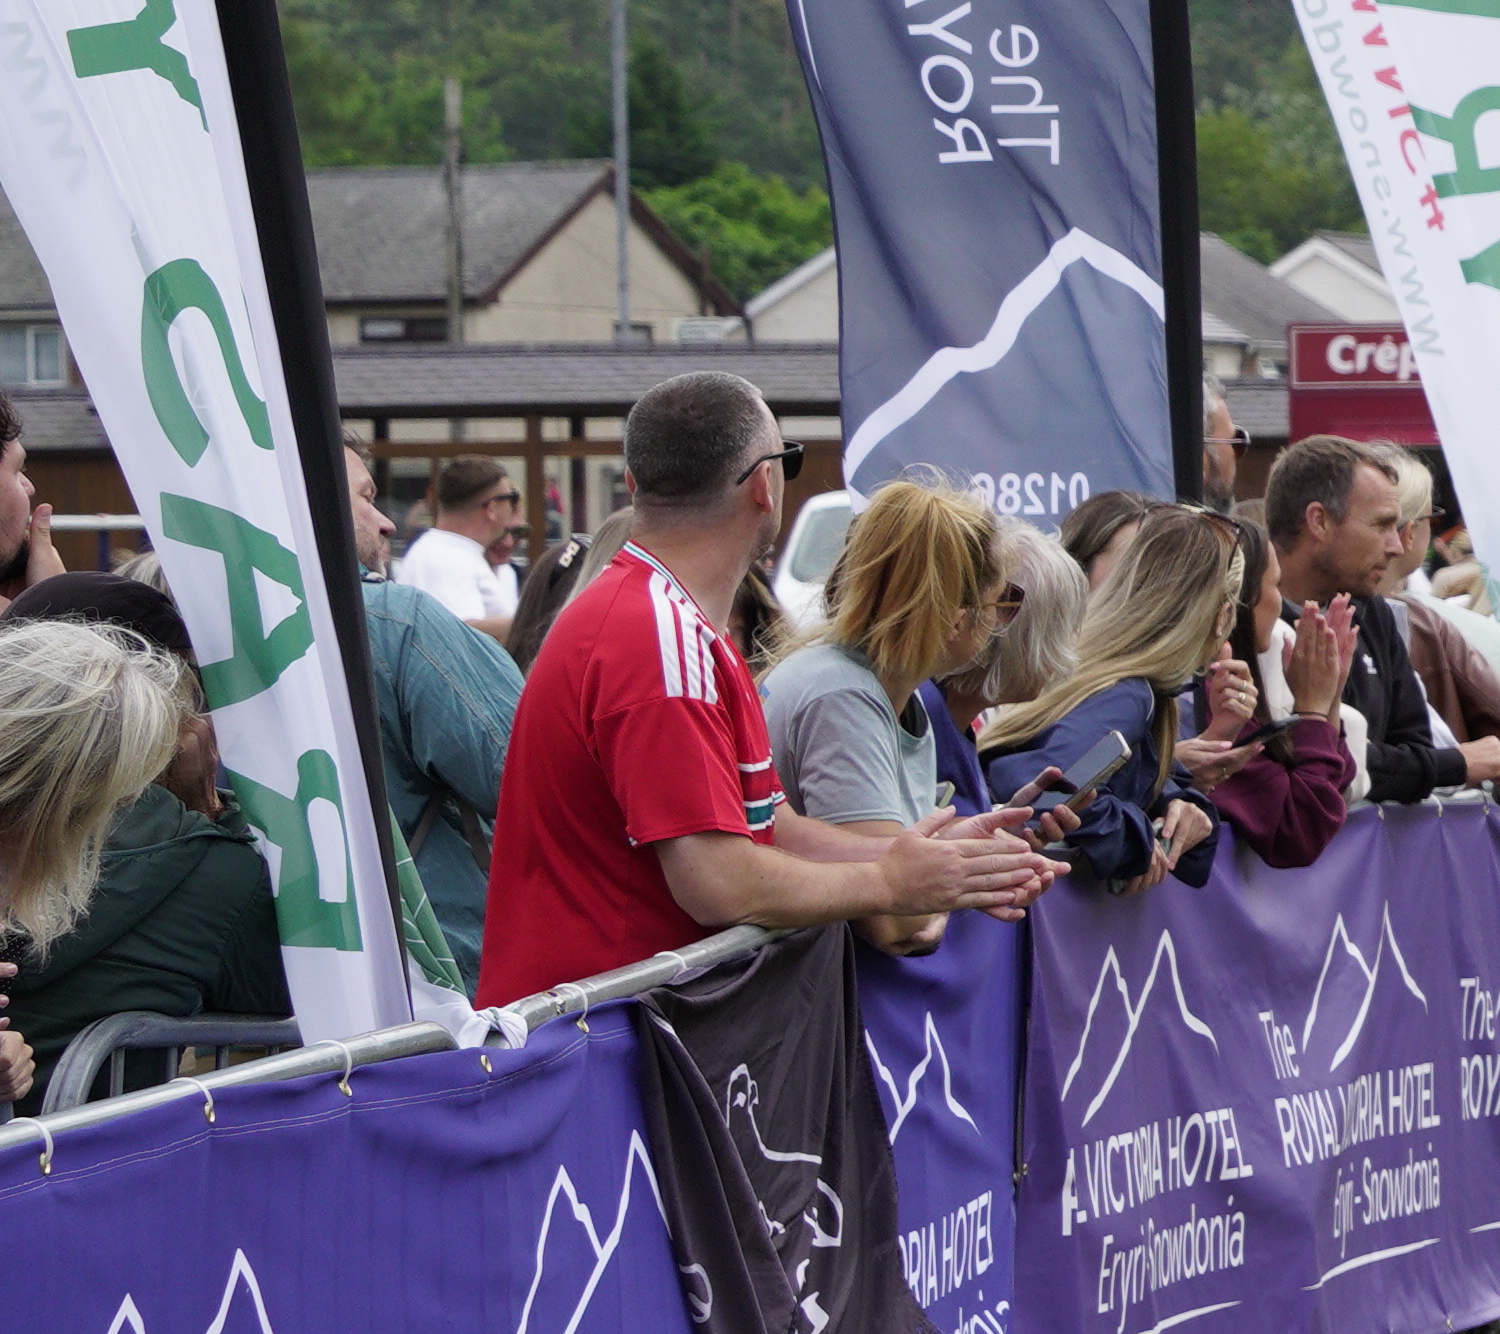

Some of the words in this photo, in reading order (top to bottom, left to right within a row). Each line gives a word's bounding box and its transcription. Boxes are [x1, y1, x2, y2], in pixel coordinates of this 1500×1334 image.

[1258, 1010, 1300, 1082] The
[1459, 976, 1496, 1044] The
[1165, 1107, 1253, 1188] HOTEL
[1274, 1089, 1339, 1169] ROYAL
[1385, 1061, 1441, 1135] HOTEL
[1362, 1141, 1441, 1228] Snowdonia
